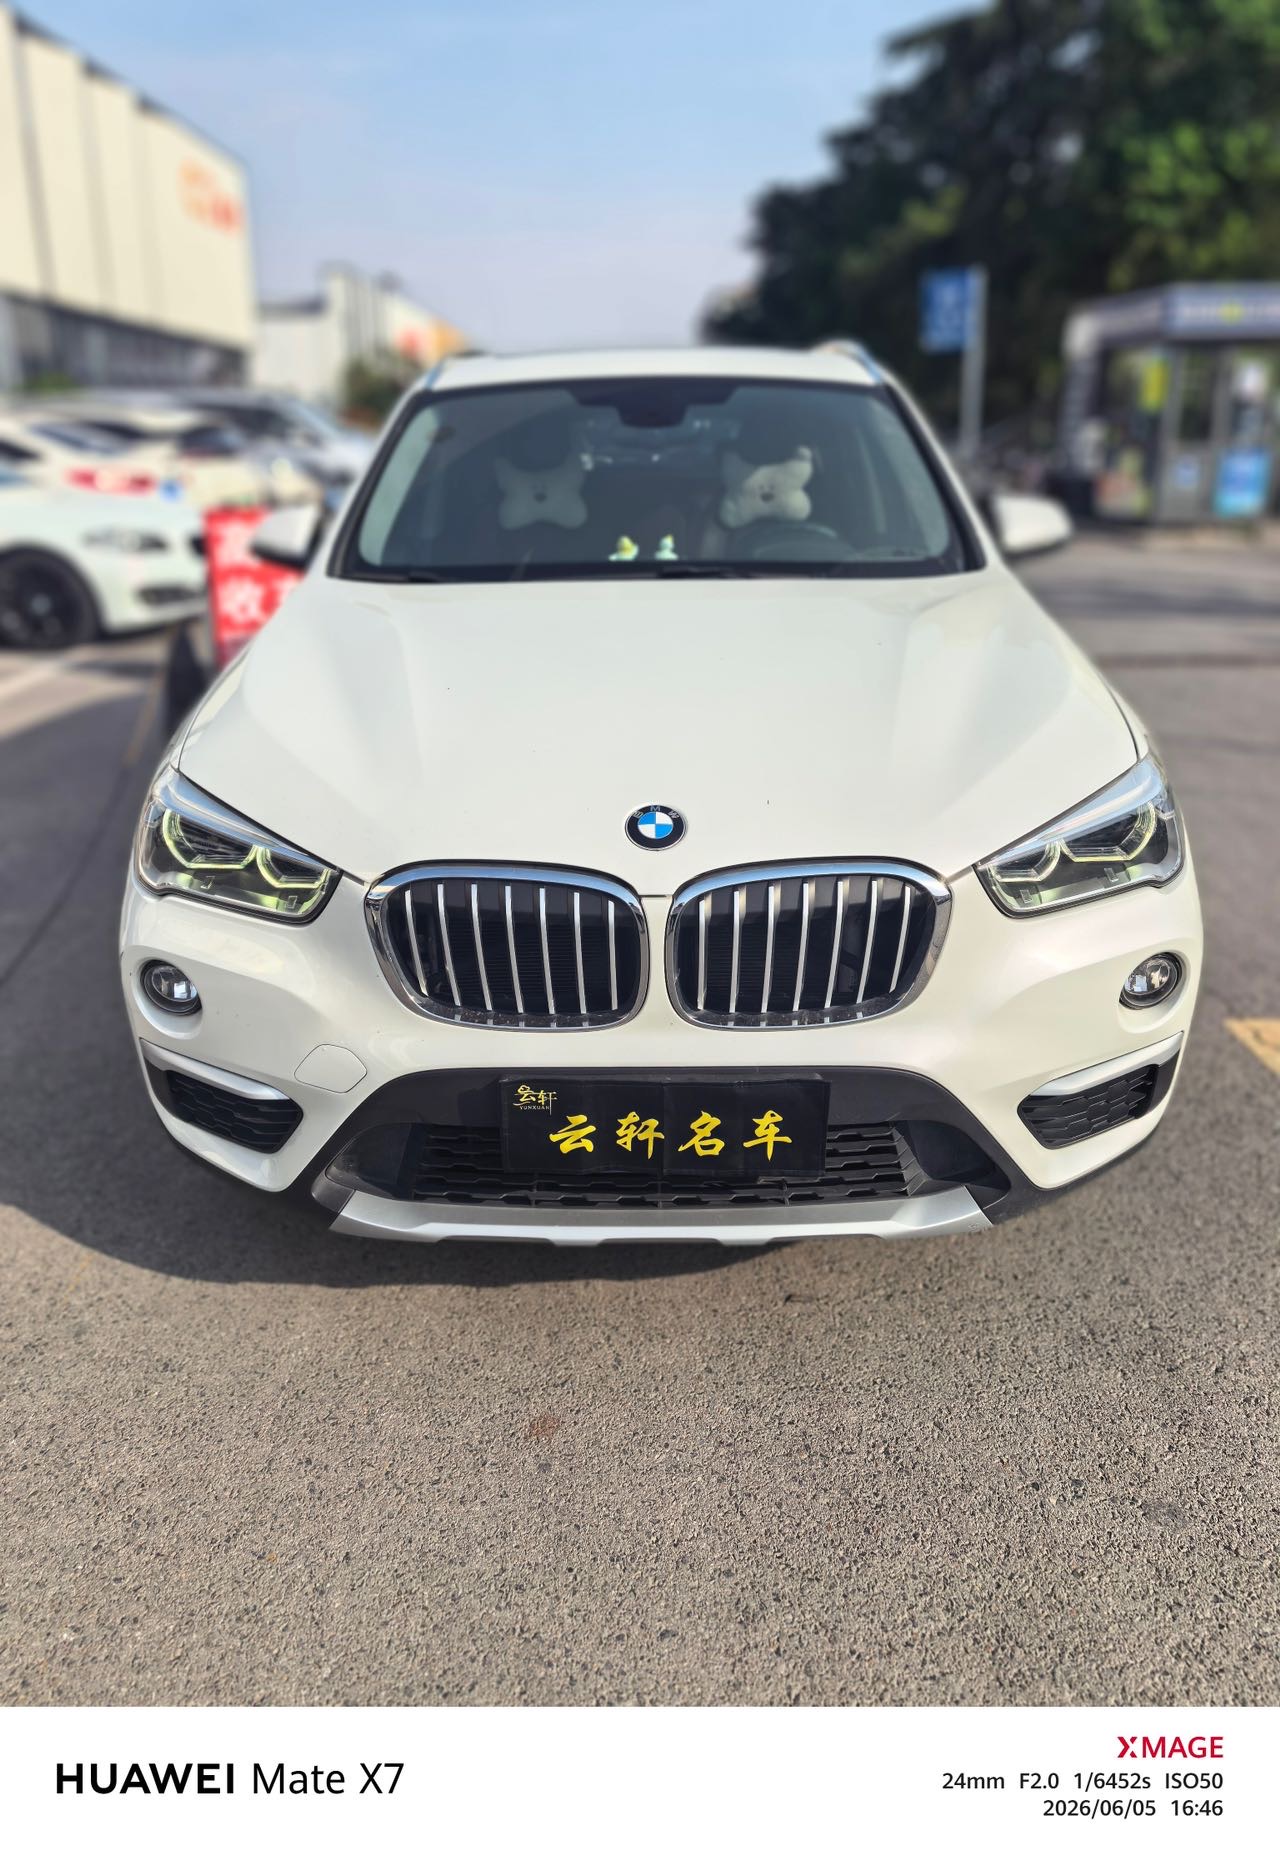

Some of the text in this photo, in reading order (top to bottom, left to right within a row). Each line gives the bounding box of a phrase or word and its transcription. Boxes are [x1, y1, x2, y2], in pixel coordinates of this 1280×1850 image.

[632, 805, 680, 819] BMW
[549, 1110, 792, 1161] 云轩名车
